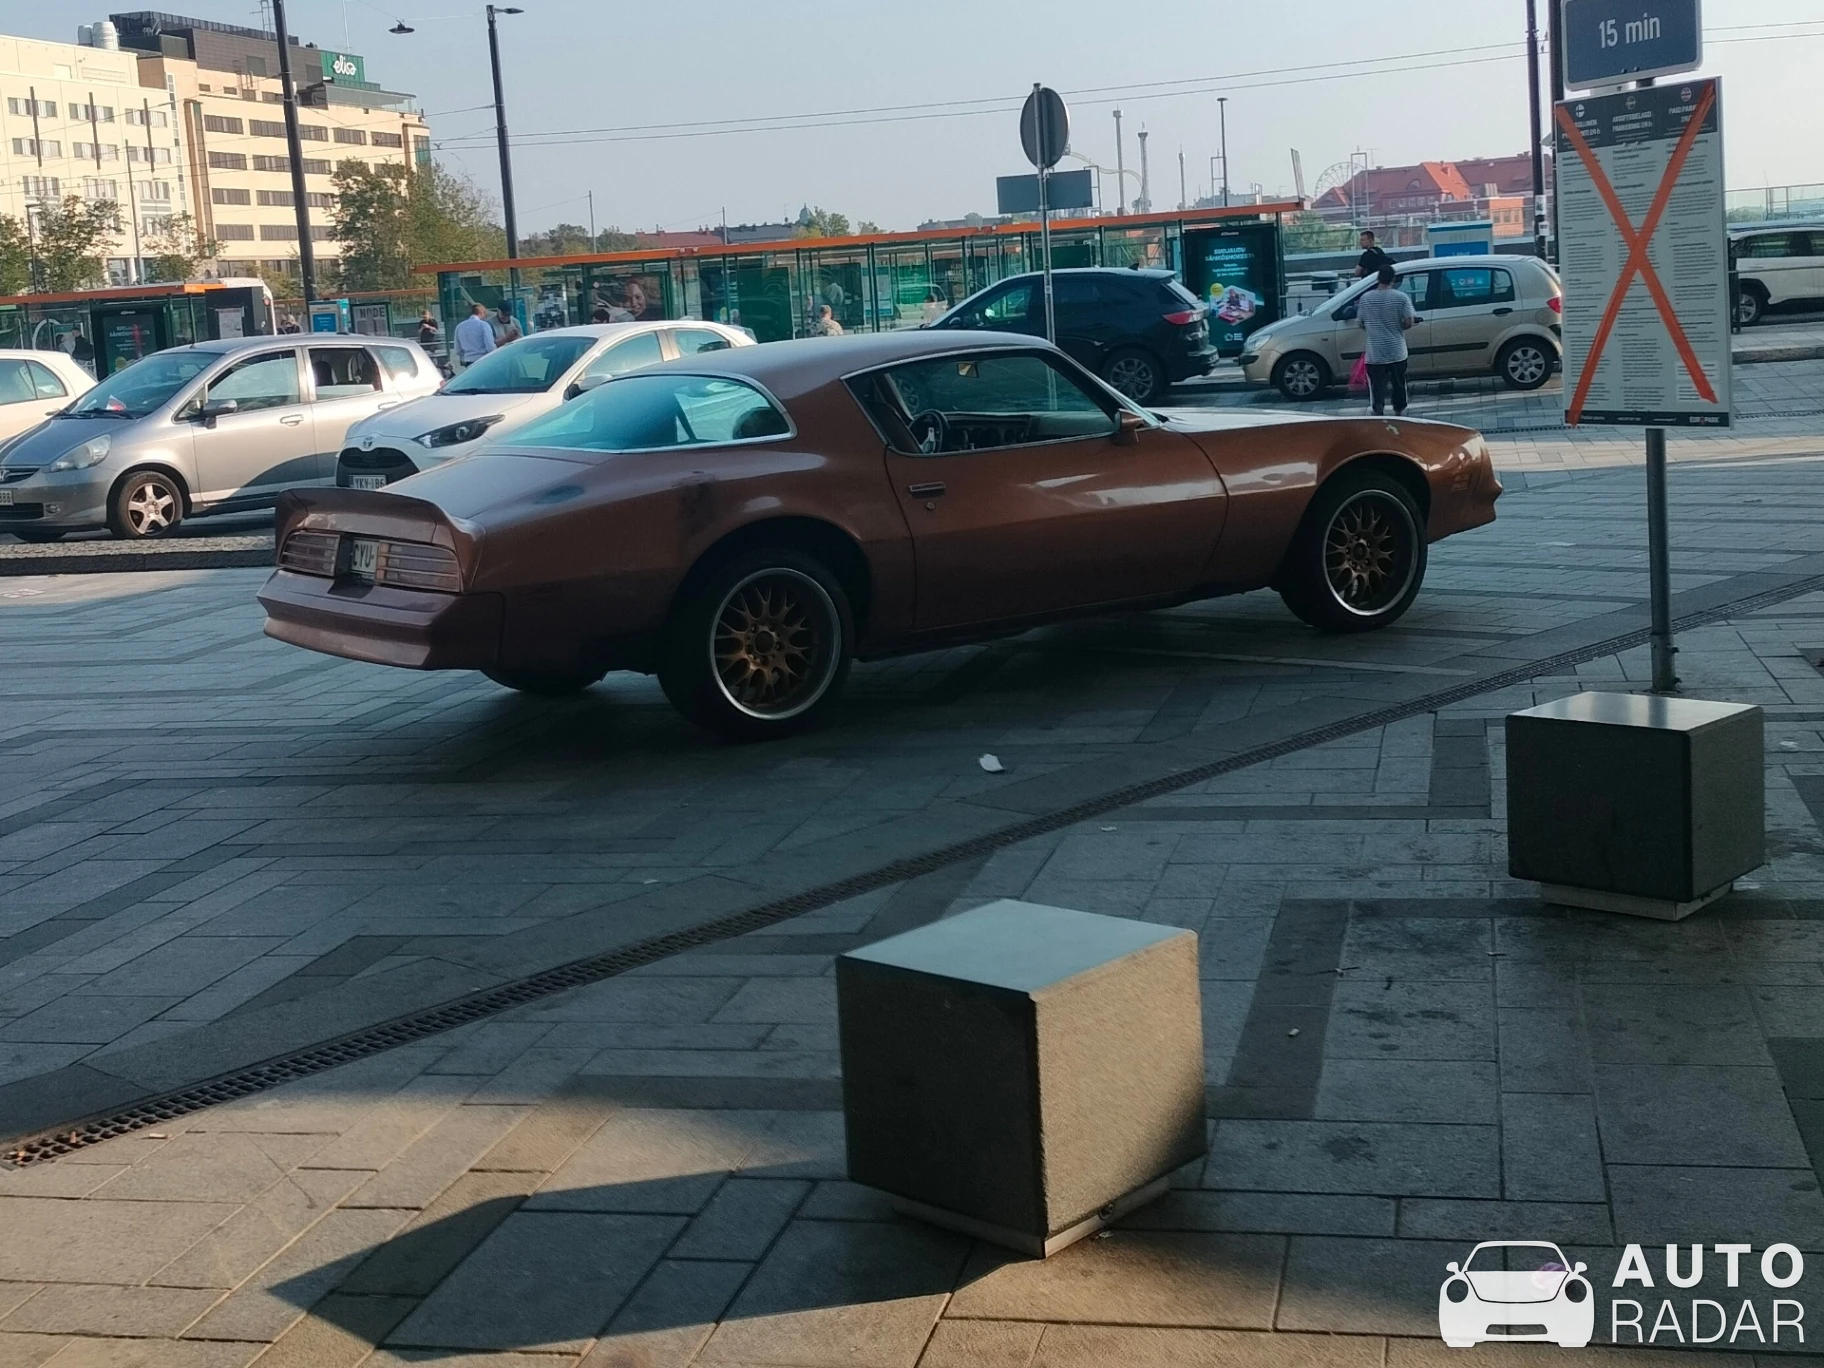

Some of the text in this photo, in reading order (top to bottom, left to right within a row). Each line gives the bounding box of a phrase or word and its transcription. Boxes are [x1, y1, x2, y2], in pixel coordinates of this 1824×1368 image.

[1599, 12, 1661, 49] 15 min
[333, 55, 357, 75] elisa
